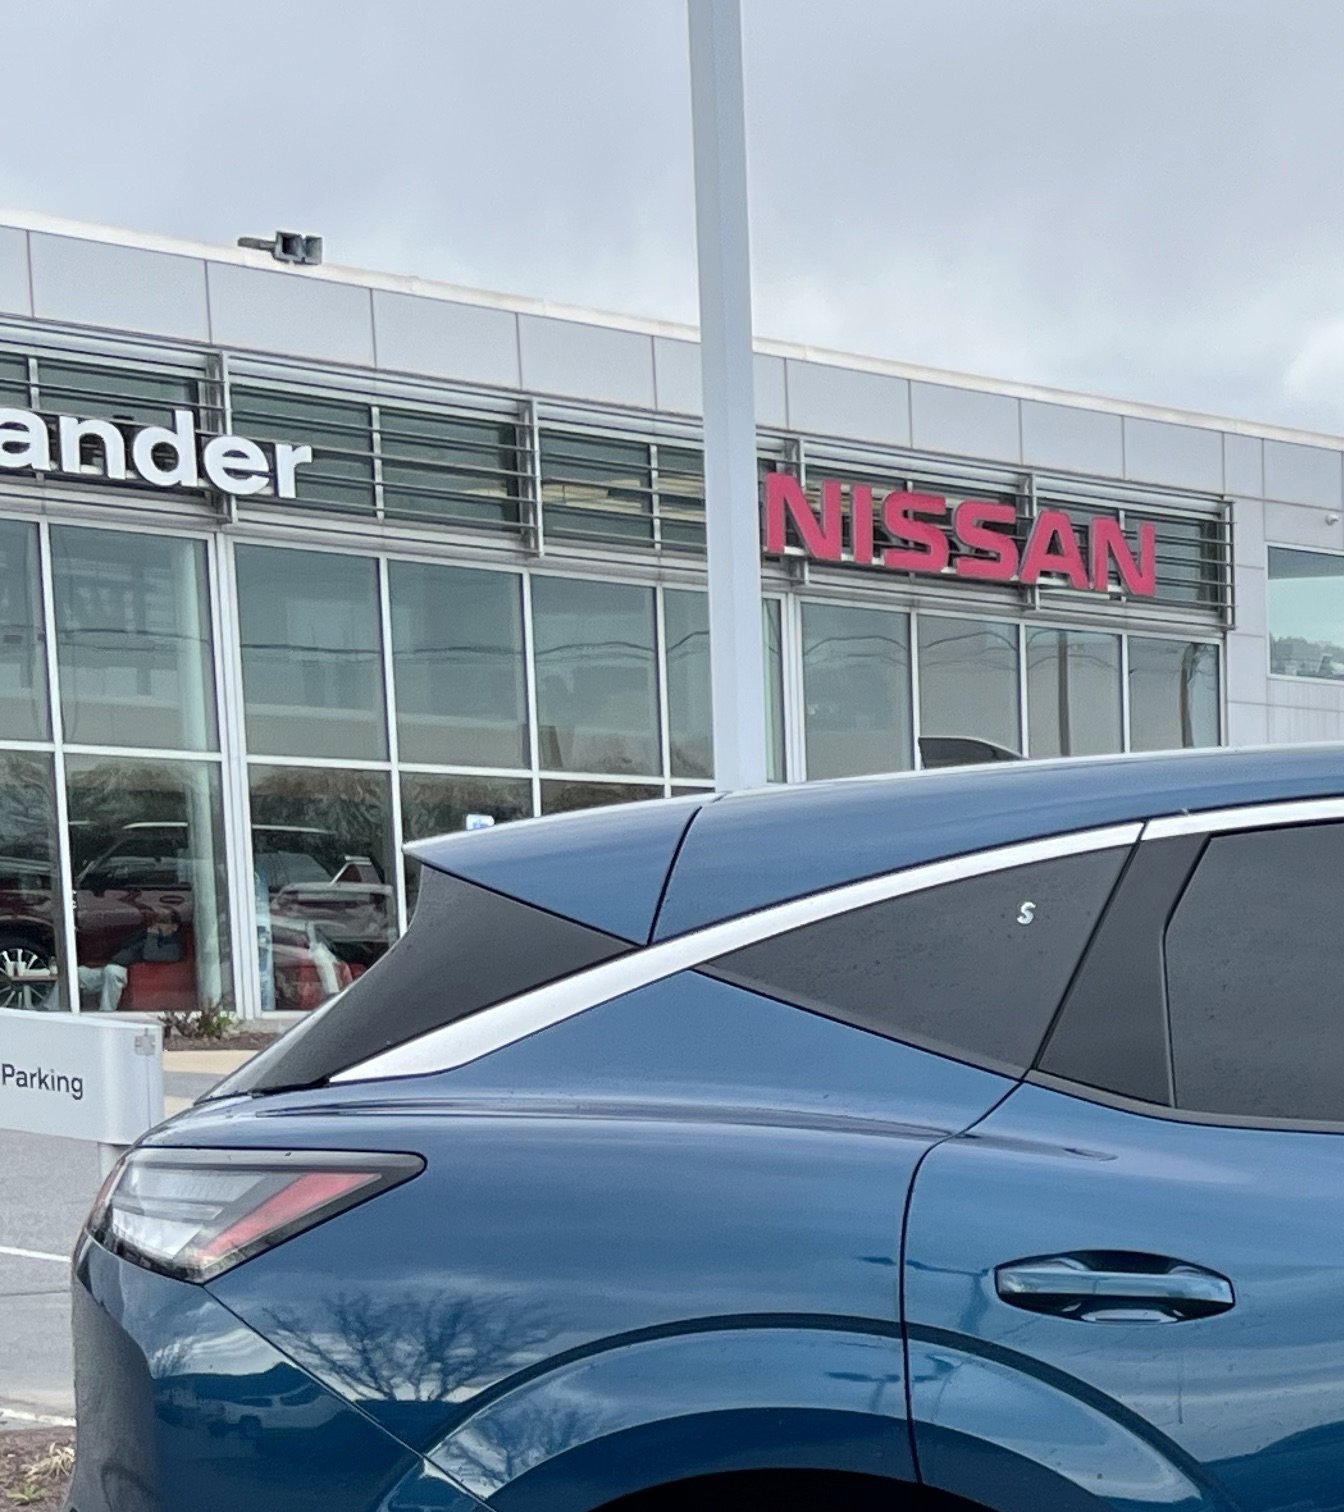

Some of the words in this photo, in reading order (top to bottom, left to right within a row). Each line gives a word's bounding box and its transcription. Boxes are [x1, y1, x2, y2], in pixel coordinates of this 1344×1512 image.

[765, 472, 1157, 597] NISSAN
[1016, 901, 1037, 925] S
[1, 1063, 84, 1101] Parking
